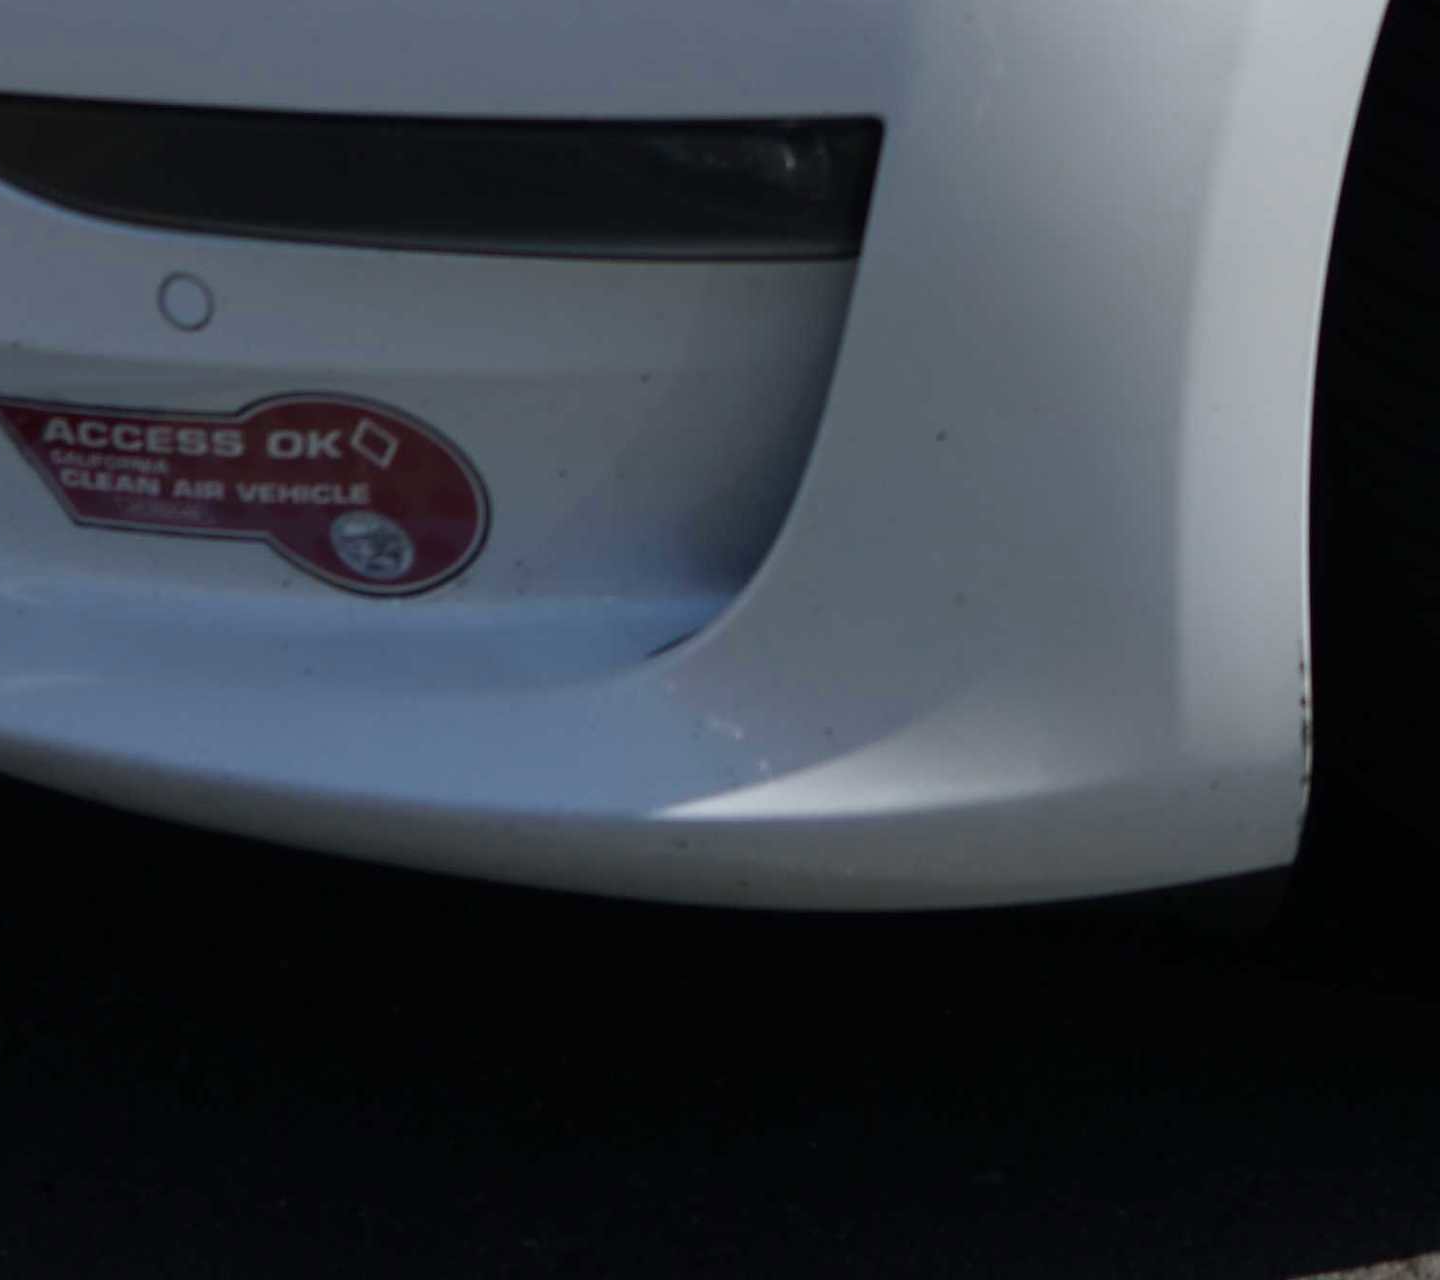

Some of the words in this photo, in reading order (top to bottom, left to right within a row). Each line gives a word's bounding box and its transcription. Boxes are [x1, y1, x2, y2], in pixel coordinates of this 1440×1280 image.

[43, 416, 245, 458] ACCESS
[265, 428, 343, 460] OK
[60, 467, 160, 497] CLEAN
[172, 478, 226, 500] AIR
[235, 481, 372, 505] VEHICLE
